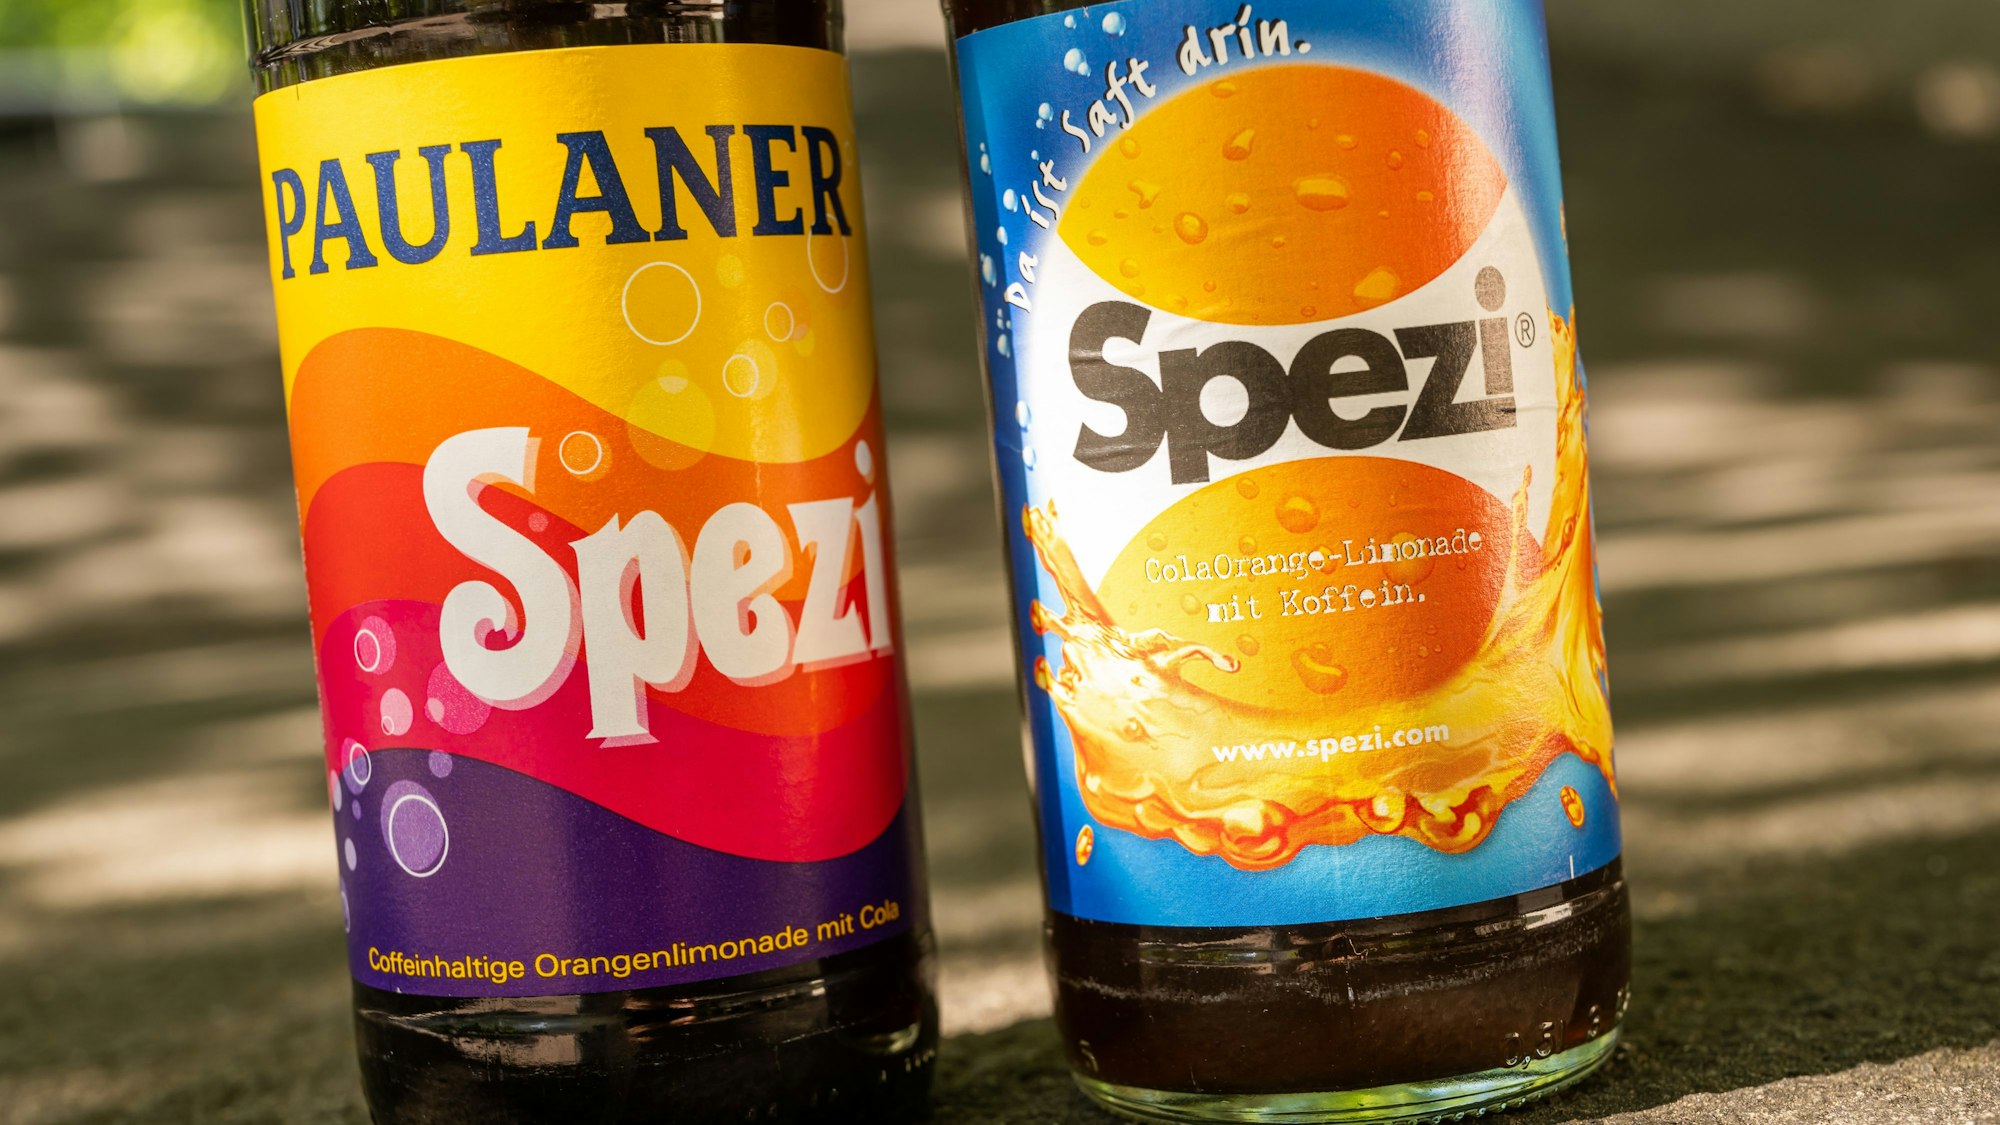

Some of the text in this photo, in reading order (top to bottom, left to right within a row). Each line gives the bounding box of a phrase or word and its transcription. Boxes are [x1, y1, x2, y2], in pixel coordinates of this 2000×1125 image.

[1060, 58, 1157, 153] Saft
[272, 125, 852, 280] PAULANER
[1020, 160, 1068, 229] ist
[1004, 250, 1038, 313] Da
[1068, 265, 1518, 486] Spezi
[423, 426, 894, 748] Spezi
[1145, 528, 1483, 584] ColaOrange-Limonade
[1206, 579, 1426, 624] mit Koffein.
[1212, 723, 1450, 763] www.spezi.com
[368, 899, 900, 984] Coffeinhaltige Orangenlimonade mit Cola
